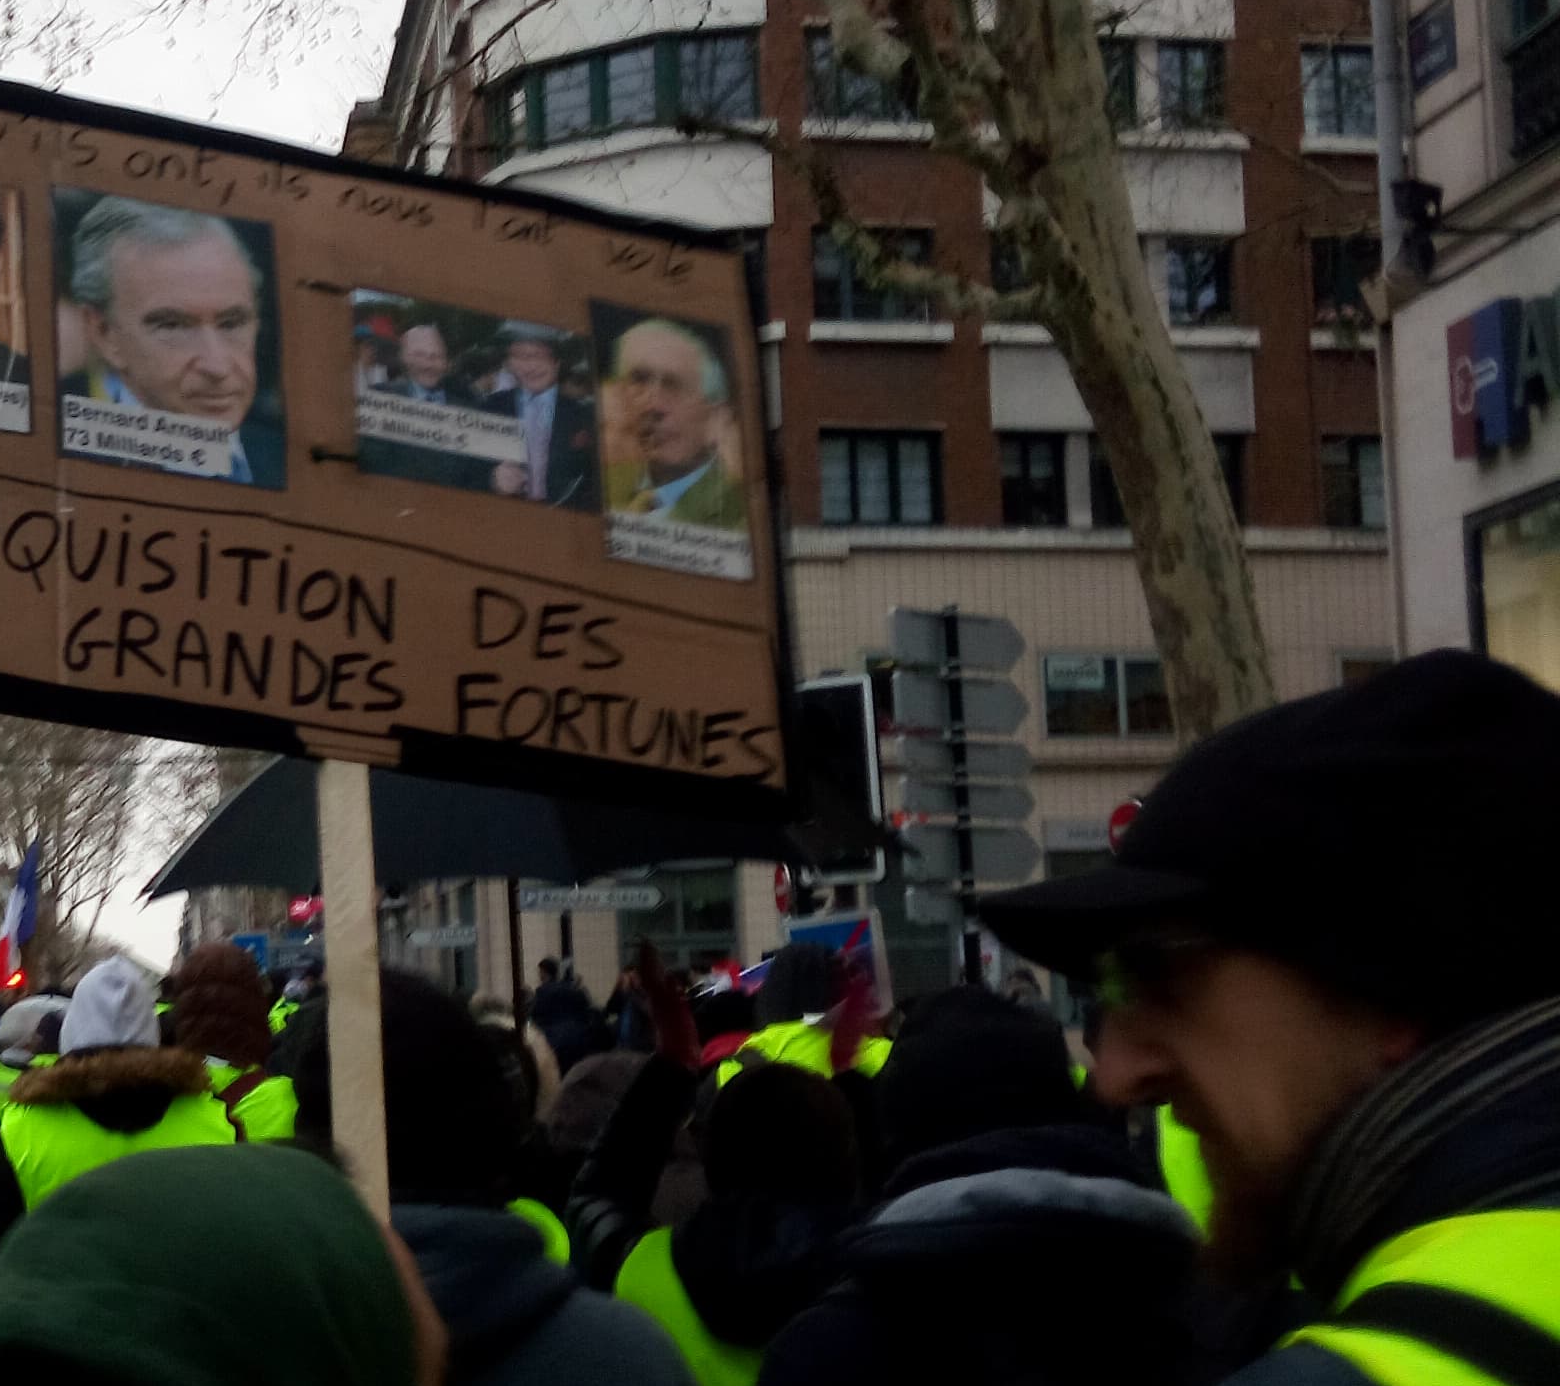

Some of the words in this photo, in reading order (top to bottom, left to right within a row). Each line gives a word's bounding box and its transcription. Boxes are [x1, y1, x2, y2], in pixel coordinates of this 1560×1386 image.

[259, 161, 310, 200] ils
[337, 184, 434, 228] nous
[65, 399, 150, 431] Bernard
[153, 416, 231, 444] Arnault
[65, 426, 90, 447] 73
[96, 432, 185, 463] Milliards
[190, 448, 207, 467] €
[474, 586, 625, 670] DES
[64, 606, 405, 713] GRANDES
[456, 673, 780, 781] FORTUNES
